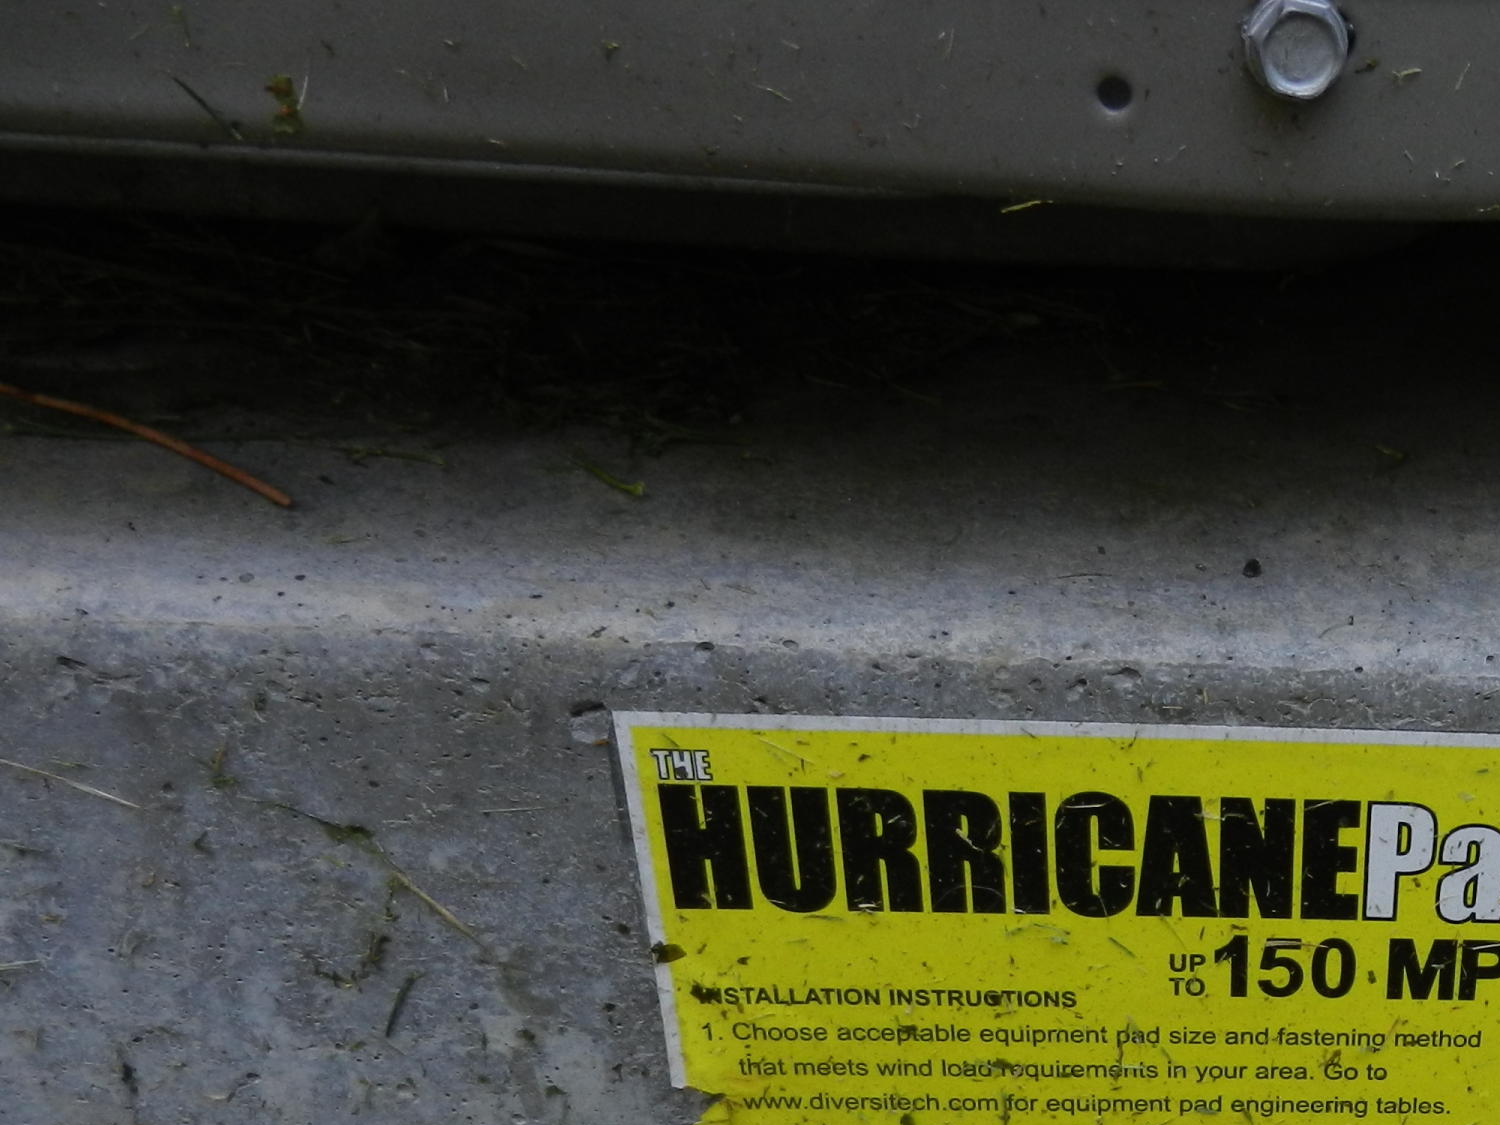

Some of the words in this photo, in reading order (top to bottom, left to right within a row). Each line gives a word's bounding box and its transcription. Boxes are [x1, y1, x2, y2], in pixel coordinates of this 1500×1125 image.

[650, 748, 713, 781] THE
[1169, 953, 1206, 972] UP
[1214, 935, 1356, 998] 150
[698, 986, 880, 1007] NSTALLATION
[889, 988, 1078, 1008] INSTRUCTIONS
[1169, 977, 1206, 996] TO
[701, 1022, 724, 1042] 1.
[732, 1021, 828, 1041] Choose
[837, 1023, 971, 1045] acceptable
[980, 1025, 1108, 1047] equipment
[1117, 1026, 1160, 1047] pad
[1169, 1027, 1216, 1045] size
[1225, 1027, 1269, 1046] and
[1277, 1028, 1386, 1050] fastening
[1394, 1030, 1482, 1048] method
[739, 1057, 787, 1076] that
[794, 1058, 869, 1076] meets
[876, 1058, 933, 1077] wind
[942, 1058, 992, 1078] load
[1001, 1060, 1159, 1083] requirements
[1167, 1061, 1187, 1079] in
[1195, 1063, 1248, 1083] your
[1255, 1065, 1314, 1080] area.
[1323, 1062, 1358, 1081] Go
[1366, 1063, 1388, 1081] to
[743, 1092, 998, 1113] www.diversitech.com
[1005, 1094, 1038, 1112] for
[1046, 1094, 1170, 1116] equipment
[1179, 1096, 1222, 1116] pad
[1231, 1096, 1368, 1118] engineering
[1376, 1097, 1451, 1115] tables.
